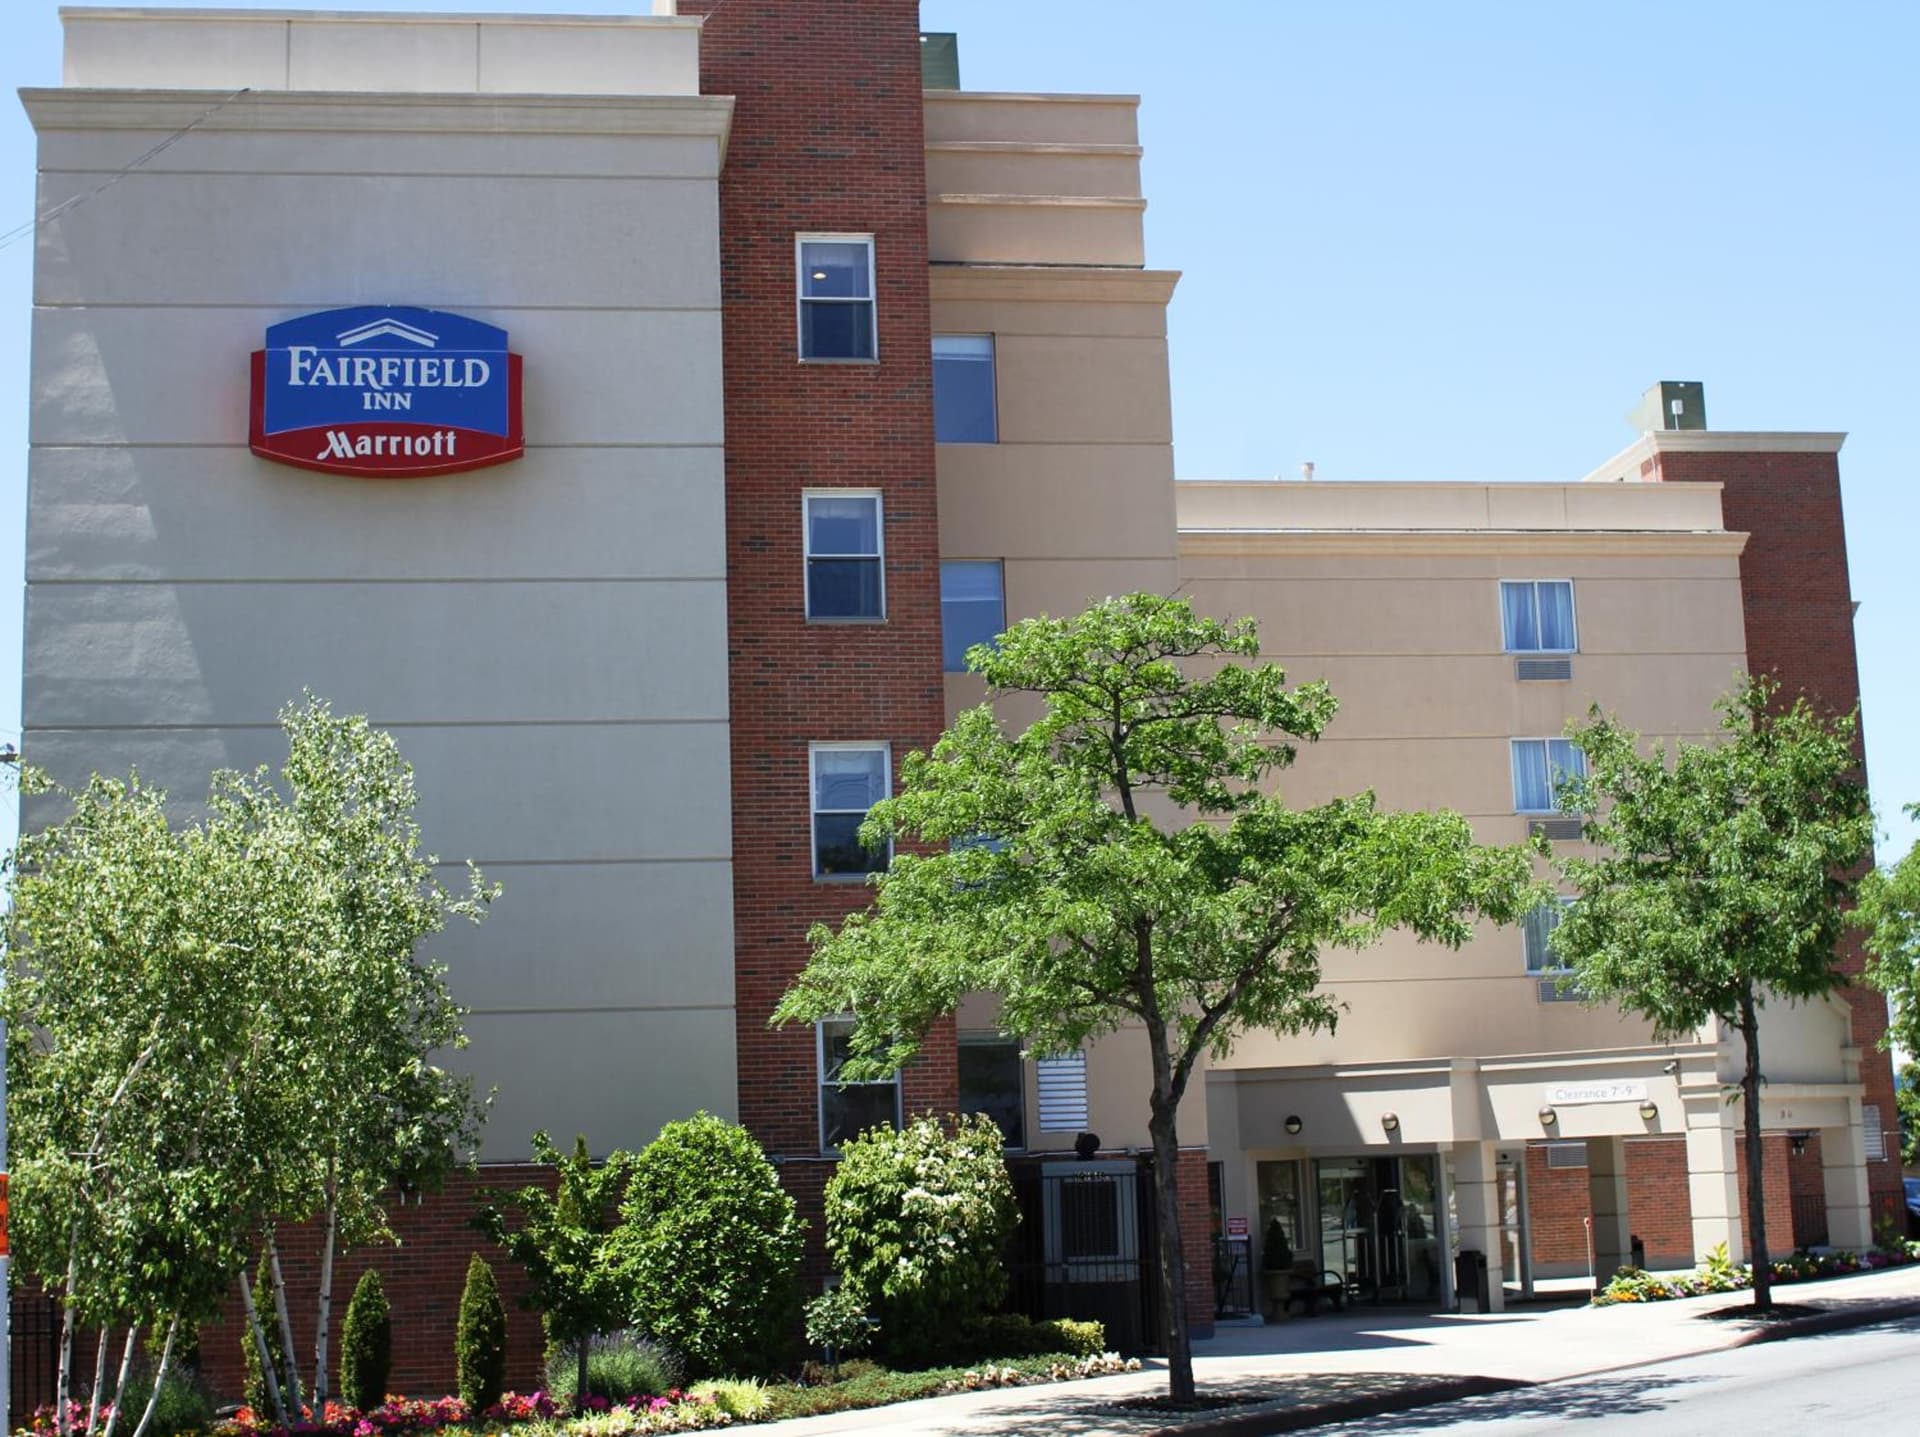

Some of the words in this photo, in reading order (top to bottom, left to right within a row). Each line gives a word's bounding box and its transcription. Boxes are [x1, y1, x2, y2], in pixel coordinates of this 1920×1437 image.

[288, 346, 490, 390] FAIRFIELD
[363, 392, 412, 410] INN
[316, 431, 456, 460] Marriott
[1555, 1088, 1608, 1100] Clearance
